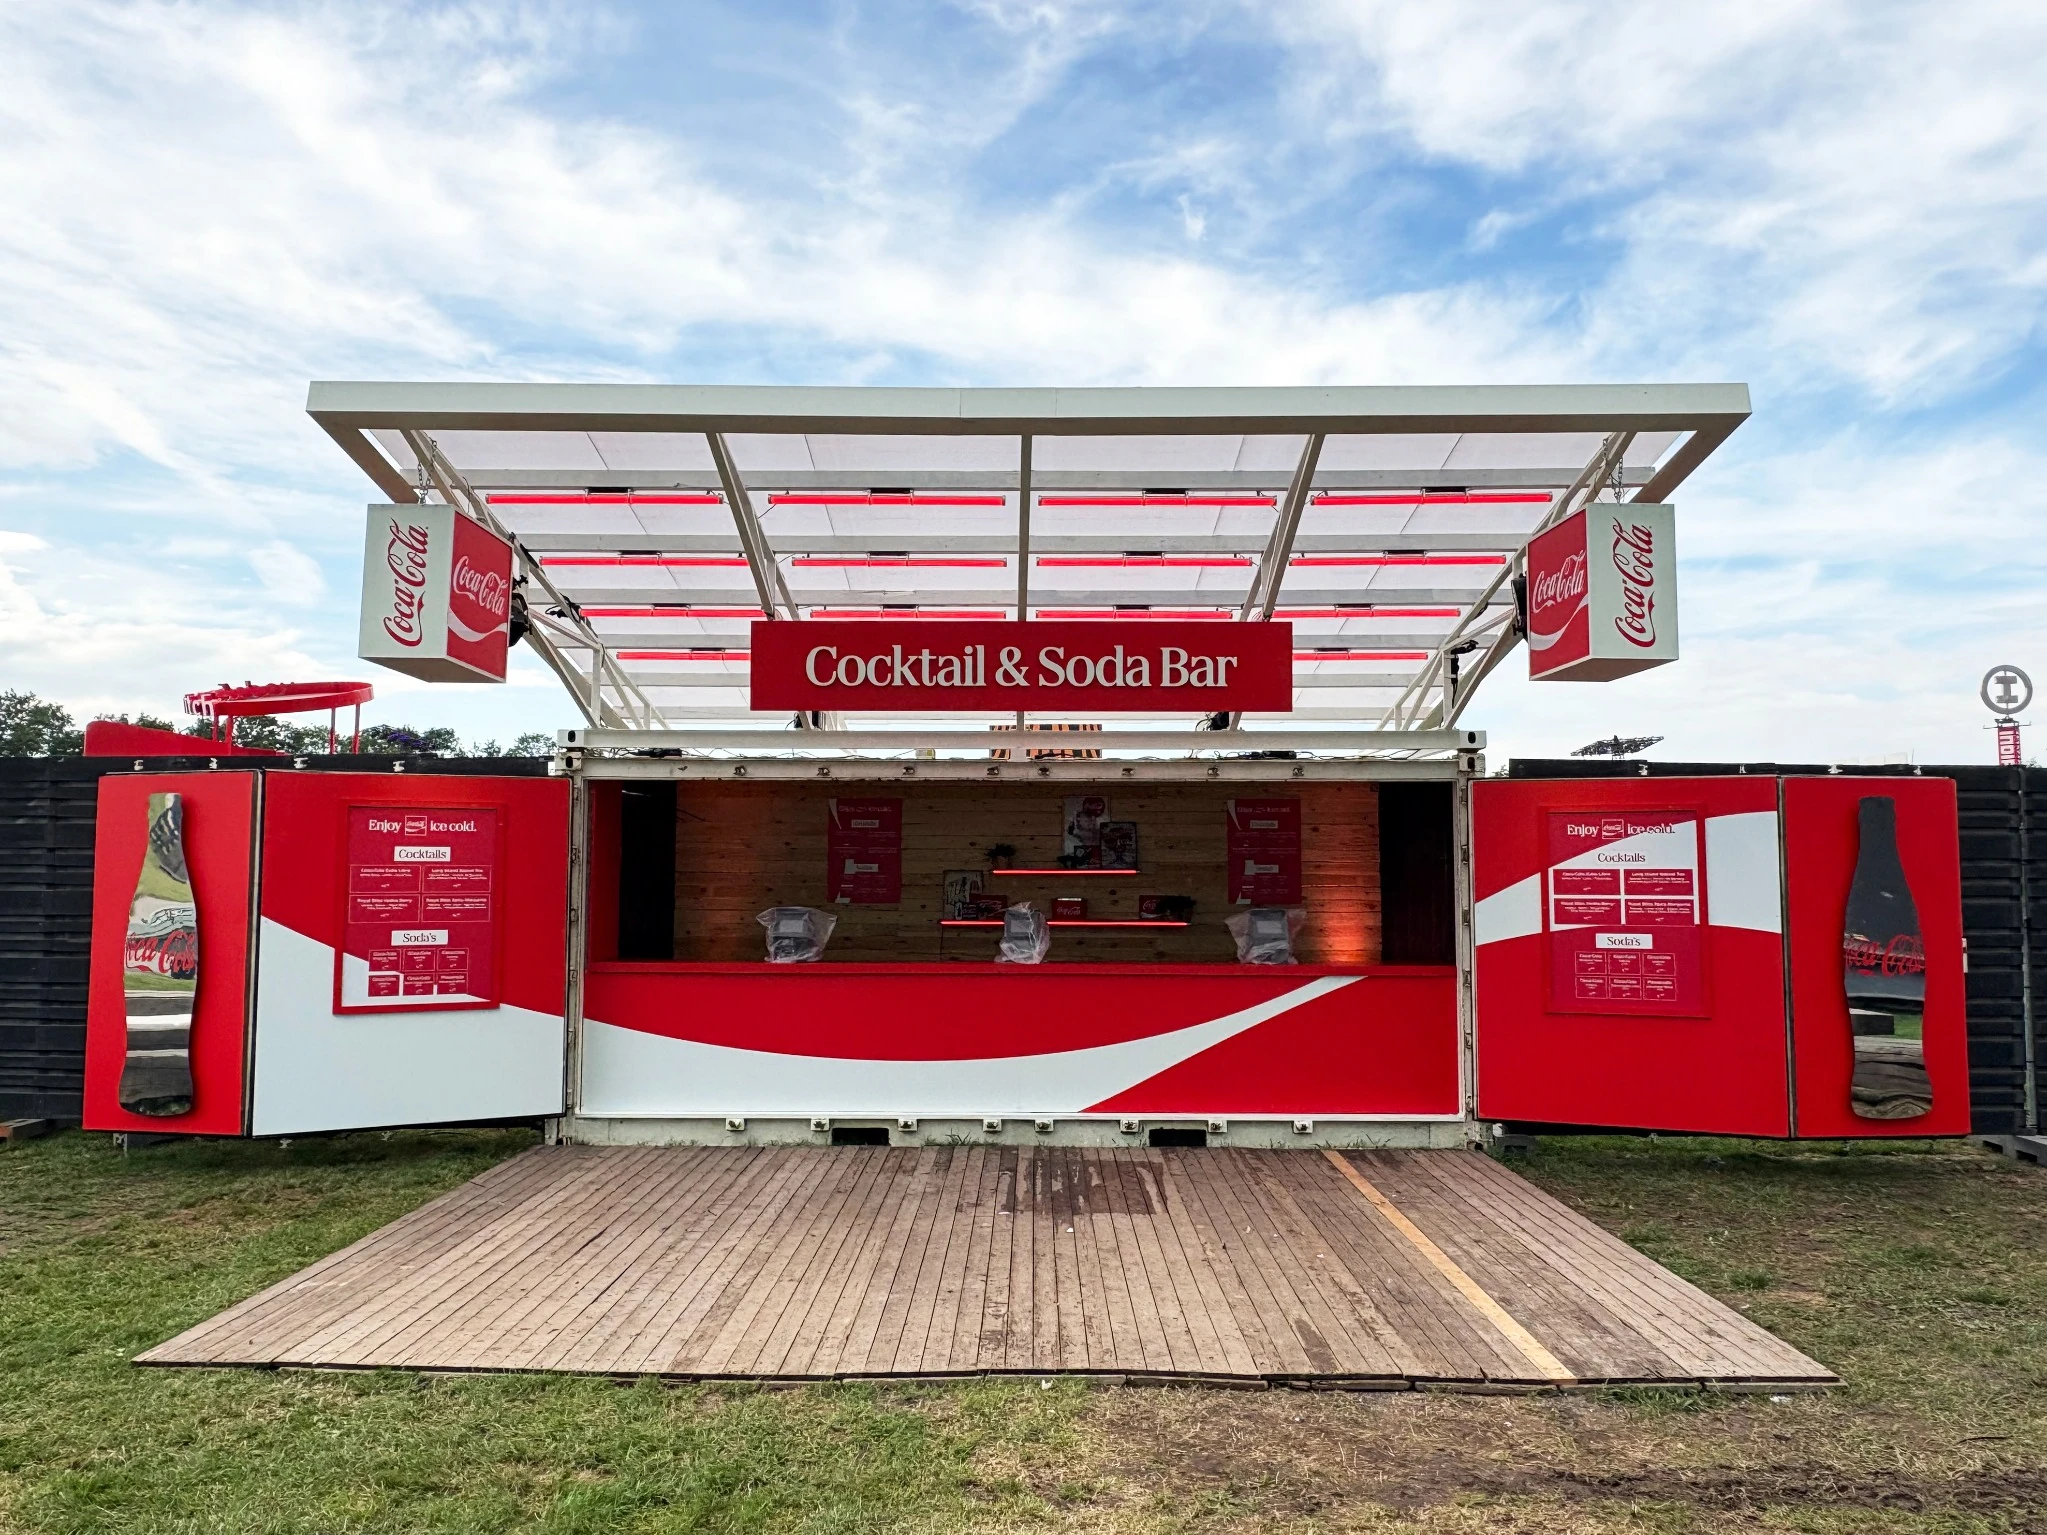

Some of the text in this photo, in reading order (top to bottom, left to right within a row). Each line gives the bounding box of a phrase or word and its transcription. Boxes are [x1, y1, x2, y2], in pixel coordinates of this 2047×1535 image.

[383, 517, 429, 646] Coca-Cola
[452, 555, 509, 616] Coca-Cola
[1532, 549, 1587, 613] Coca-Cola
[1612, 516, 1656, 647] Coca-Cola
[805, 644, 1238, 687] Cocktail & Soda Bar
[368, 819, 402, 833] Enjoy
[448, 820, 477, 832] cold.
[1567, 824, 1600, 837] Enjoy
[398, 849, 447, 859] Cocktails
[1597, 853, 1646, 863] Cocktails
[402, 932, 437, 943] Soda's
[1606, 936, 1641, 946] Soda's
